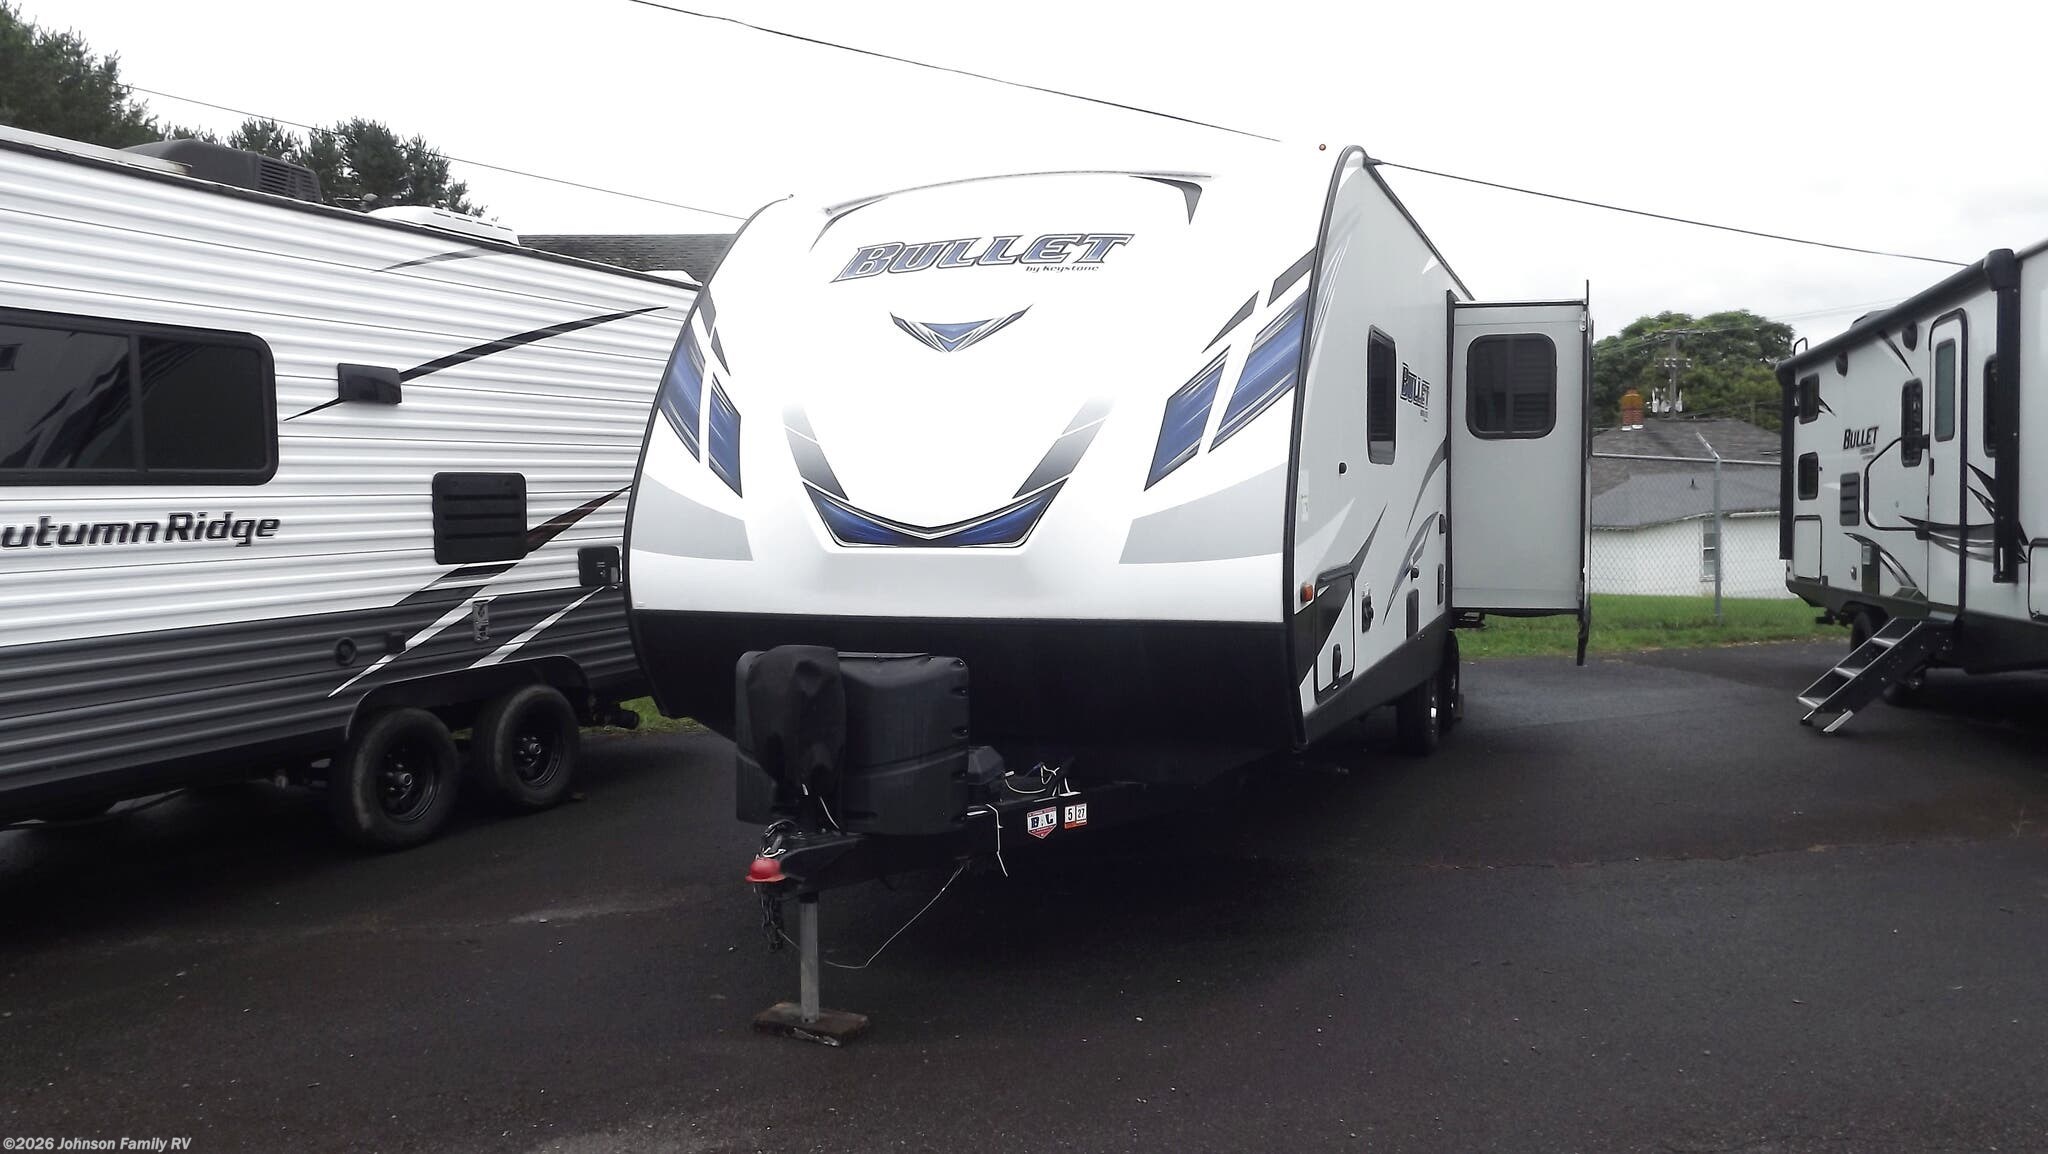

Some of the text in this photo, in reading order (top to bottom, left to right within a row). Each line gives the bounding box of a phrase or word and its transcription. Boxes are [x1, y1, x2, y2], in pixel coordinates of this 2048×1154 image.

[830, 233, 1135, 283] BULLET
[1025, 265, 1099, 273] by Keystone
[1400, 362, 1430, 410] BULLET
[1843, 426, 1879, 450] BULLET
[163, 511, 281, 547] Ridge
[1067, 808, 1073, 821] 5
